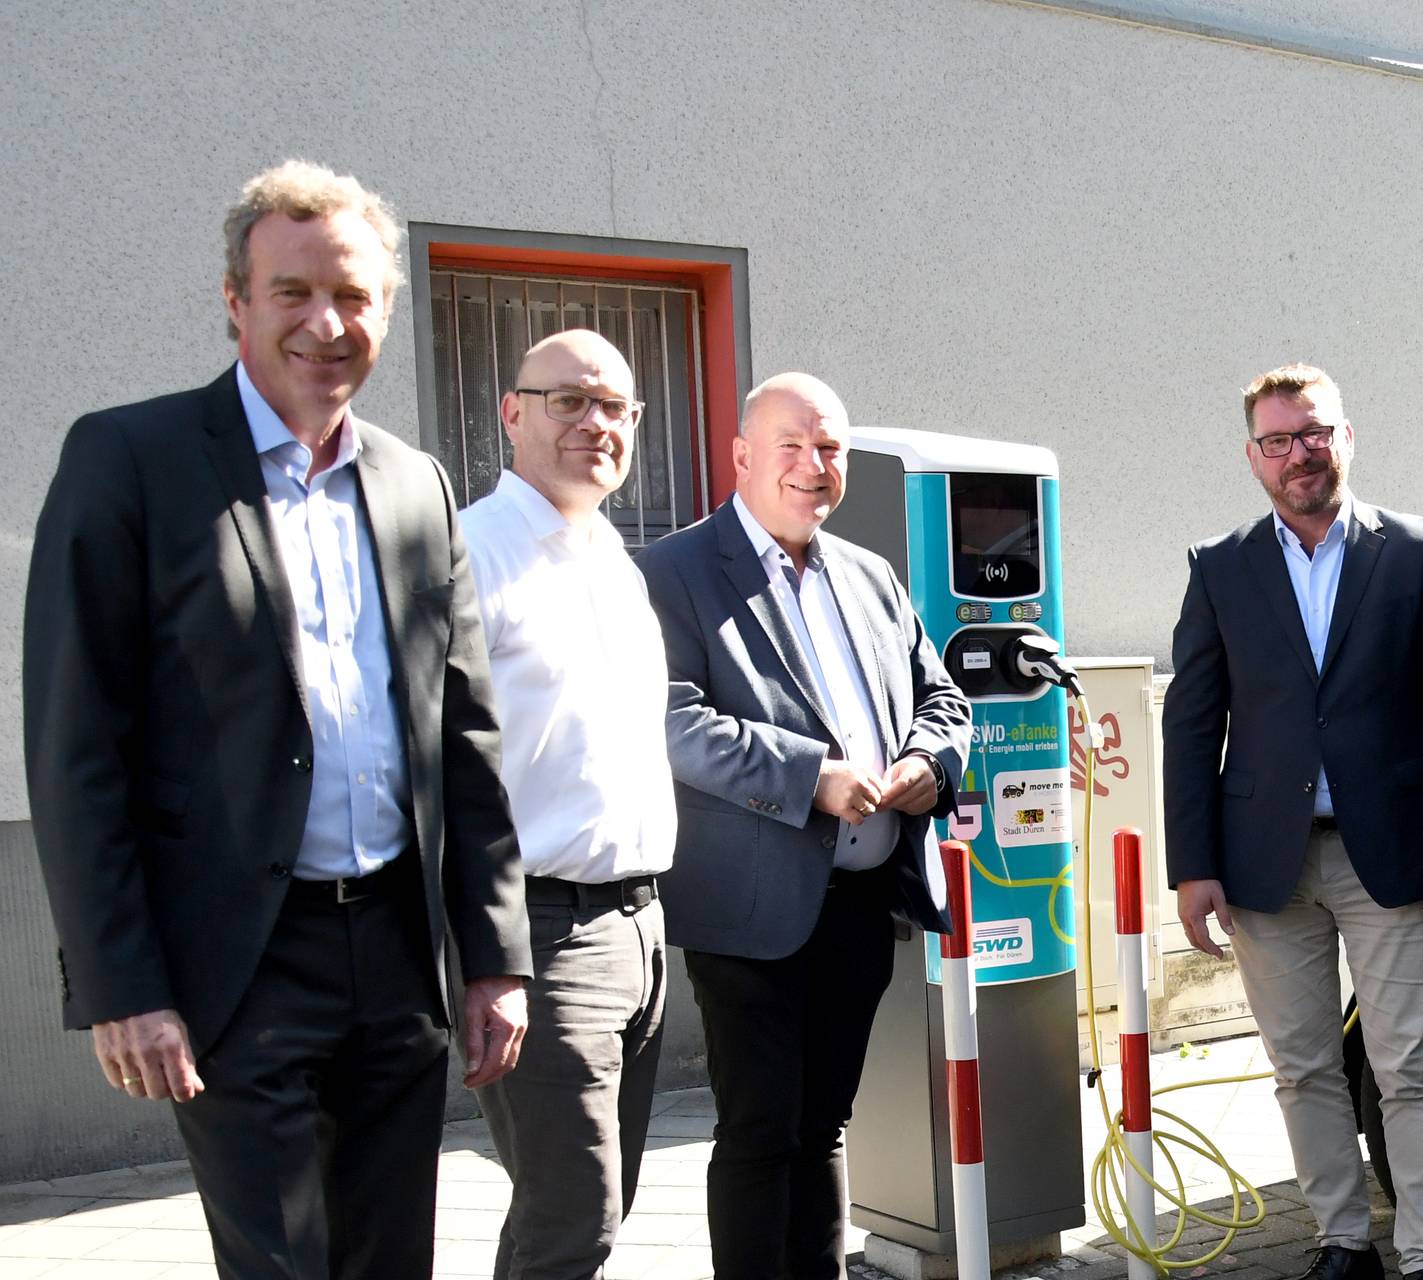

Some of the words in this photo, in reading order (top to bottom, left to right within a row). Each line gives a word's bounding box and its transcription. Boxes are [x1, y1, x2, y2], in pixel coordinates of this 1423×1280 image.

[989, 744, 1014, 754] Energie
[1016, 743, 1034, 752] mobil
[1035, 742, 1058, 751] erleben
[1030, 783, 1051, 791] move
[1003, 827, 1021, 836] Stadt
[973, 936, 1023, 954] SWD
